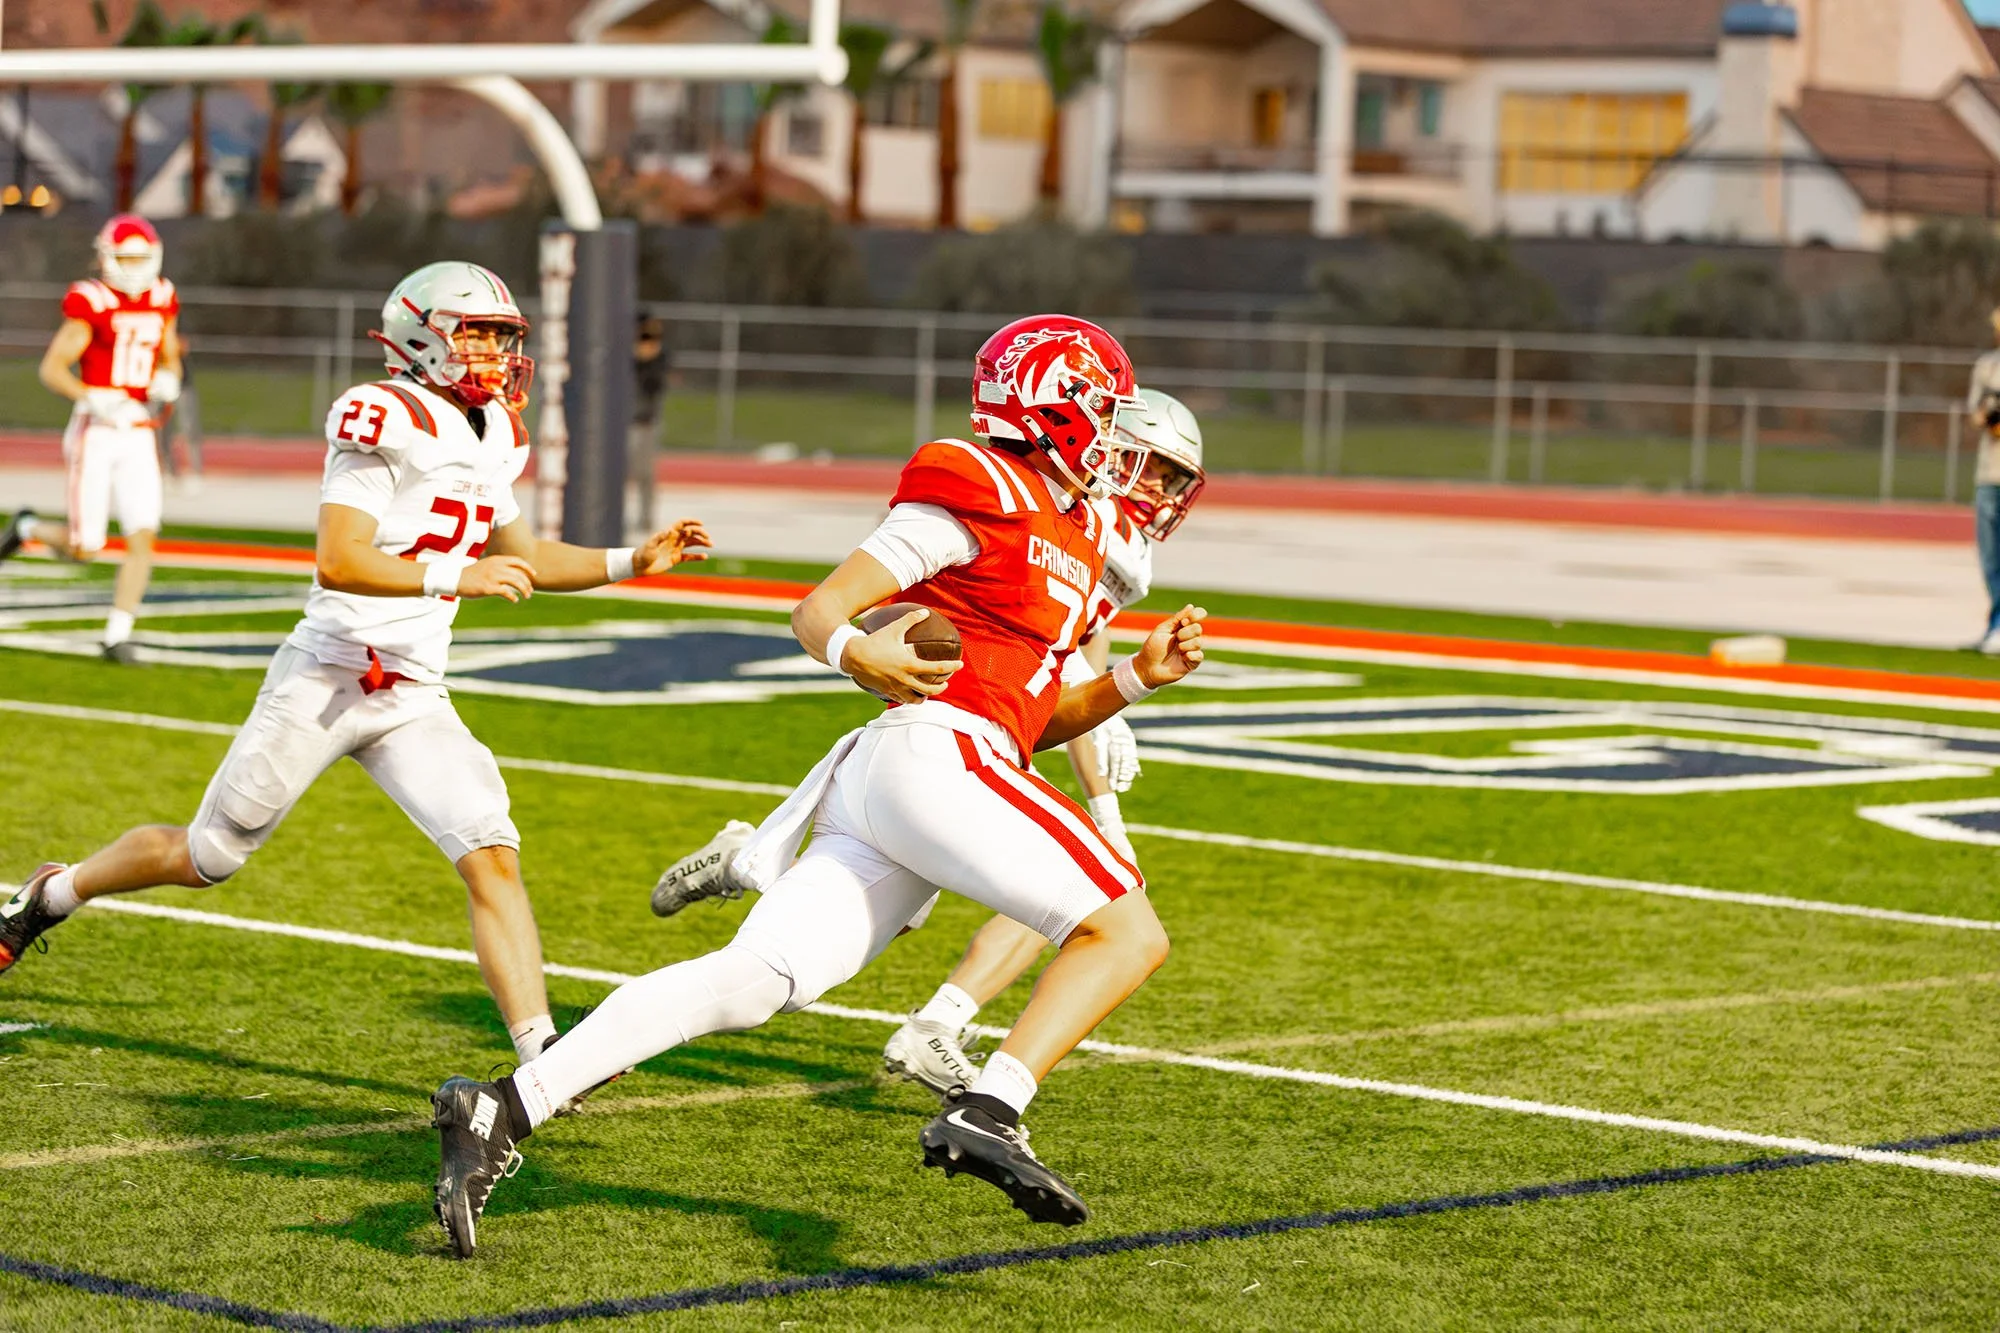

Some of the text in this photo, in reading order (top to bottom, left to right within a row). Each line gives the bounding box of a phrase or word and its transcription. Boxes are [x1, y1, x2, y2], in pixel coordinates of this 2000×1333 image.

[337, 400, 388, 446] 23
[1027, 534, 1091, 598] CRIMSON
[1025, 575, 1084, 698] 7
[666, 852, 721, 887] BATTLE
[927, 1038, 974, 1088] BATTLE
